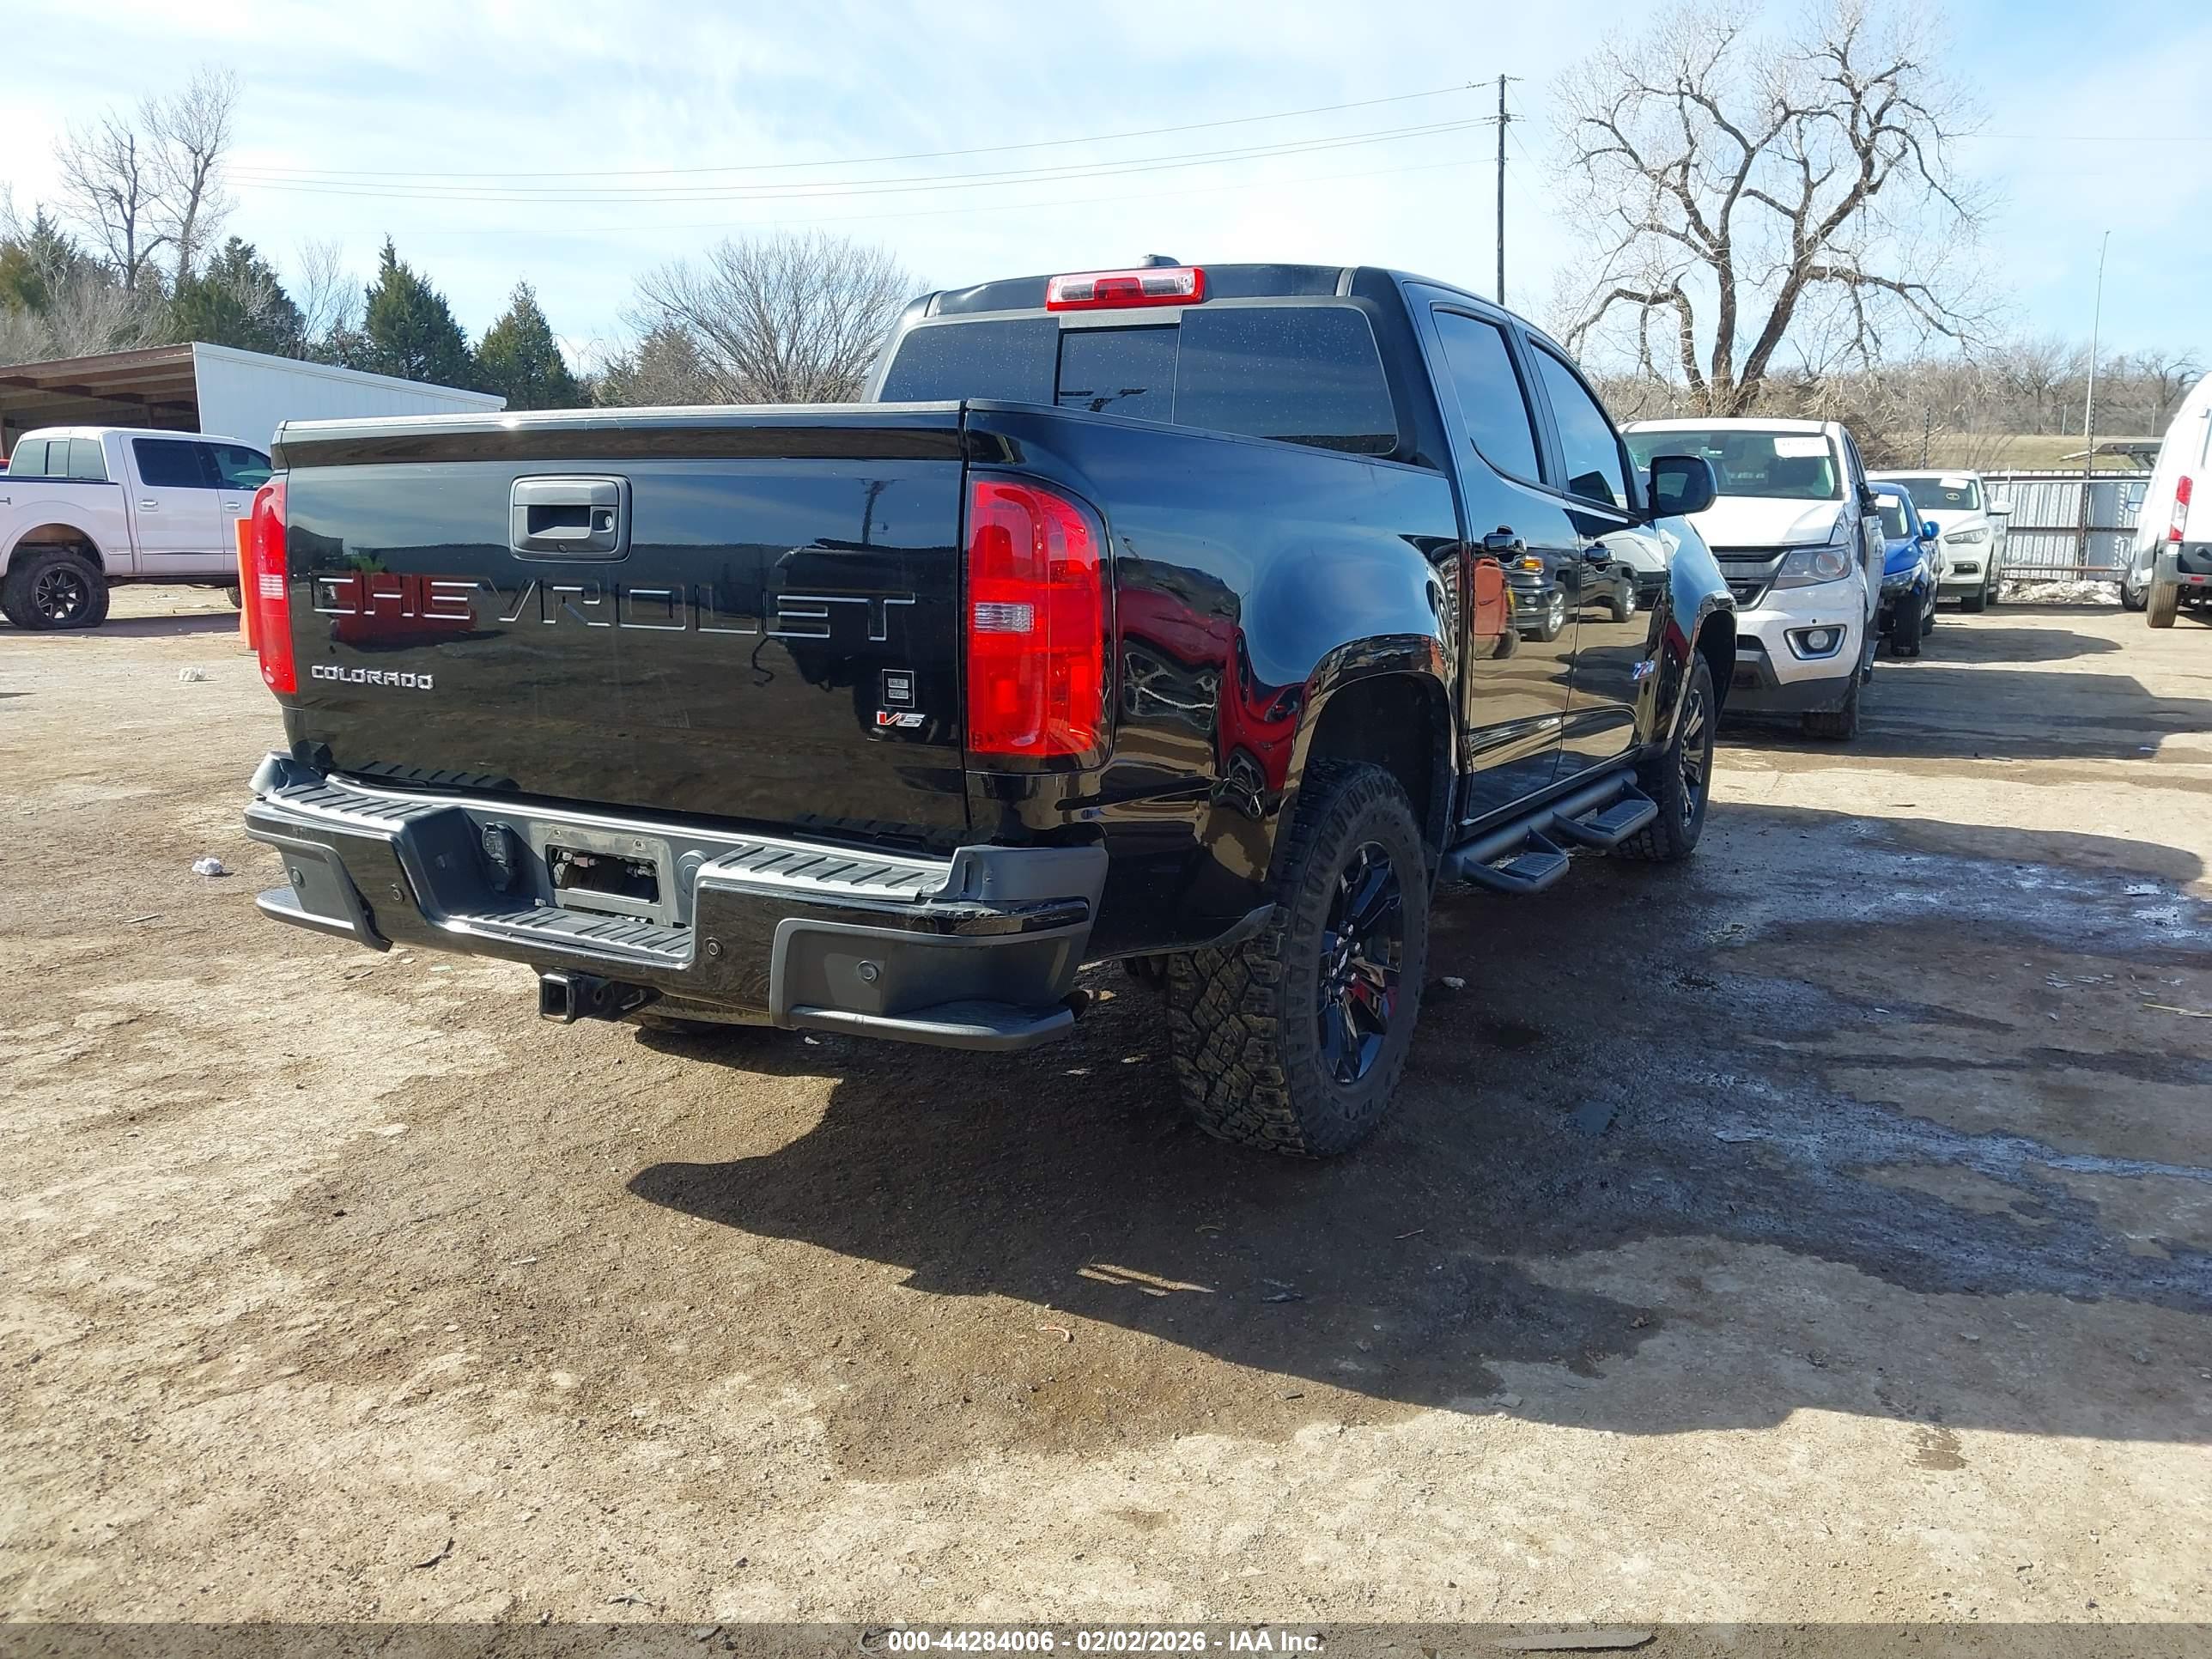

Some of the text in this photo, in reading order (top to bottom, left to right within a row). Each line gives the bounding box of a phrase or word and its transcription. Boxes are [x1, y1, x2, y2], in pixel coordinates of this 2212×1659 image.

[310, 569, 916, 641] CHEVROLET
[311, 664, 434, 690] COLORADO
[876, 710, 926, 727] V6
